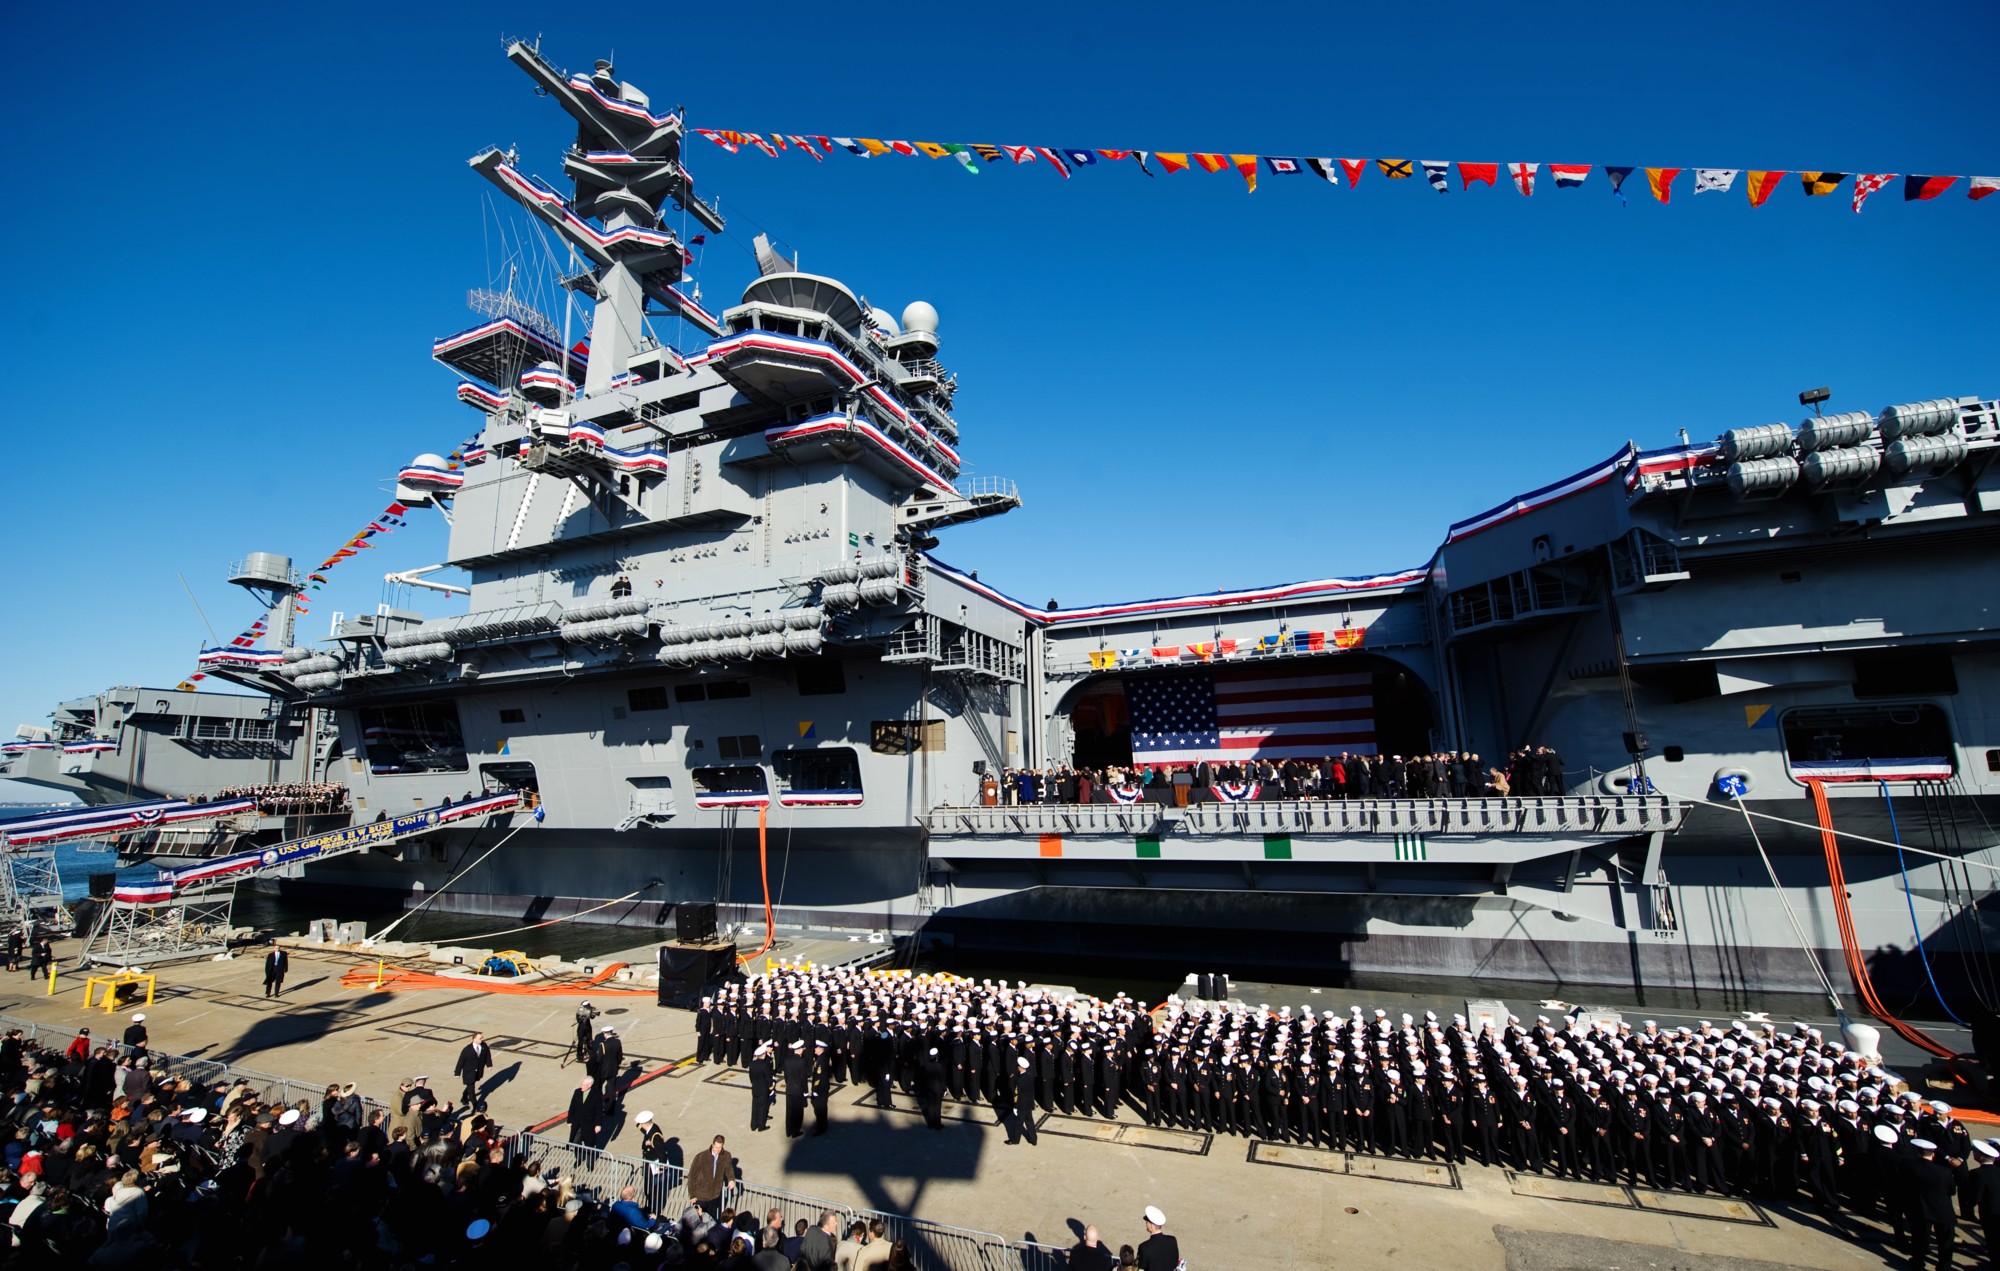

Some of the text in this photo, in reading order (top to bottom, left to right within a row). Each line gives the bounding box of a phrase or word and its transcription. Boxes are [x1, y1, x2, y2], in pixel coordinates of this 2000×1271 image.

[278, 844, 299, 855] USS
[301, 833, 344, 849] GEORGE
[368, 821, 394, 833] BUSH
[397, 816, 416, 826] CVN
[417, 814, 425, 822] 77
